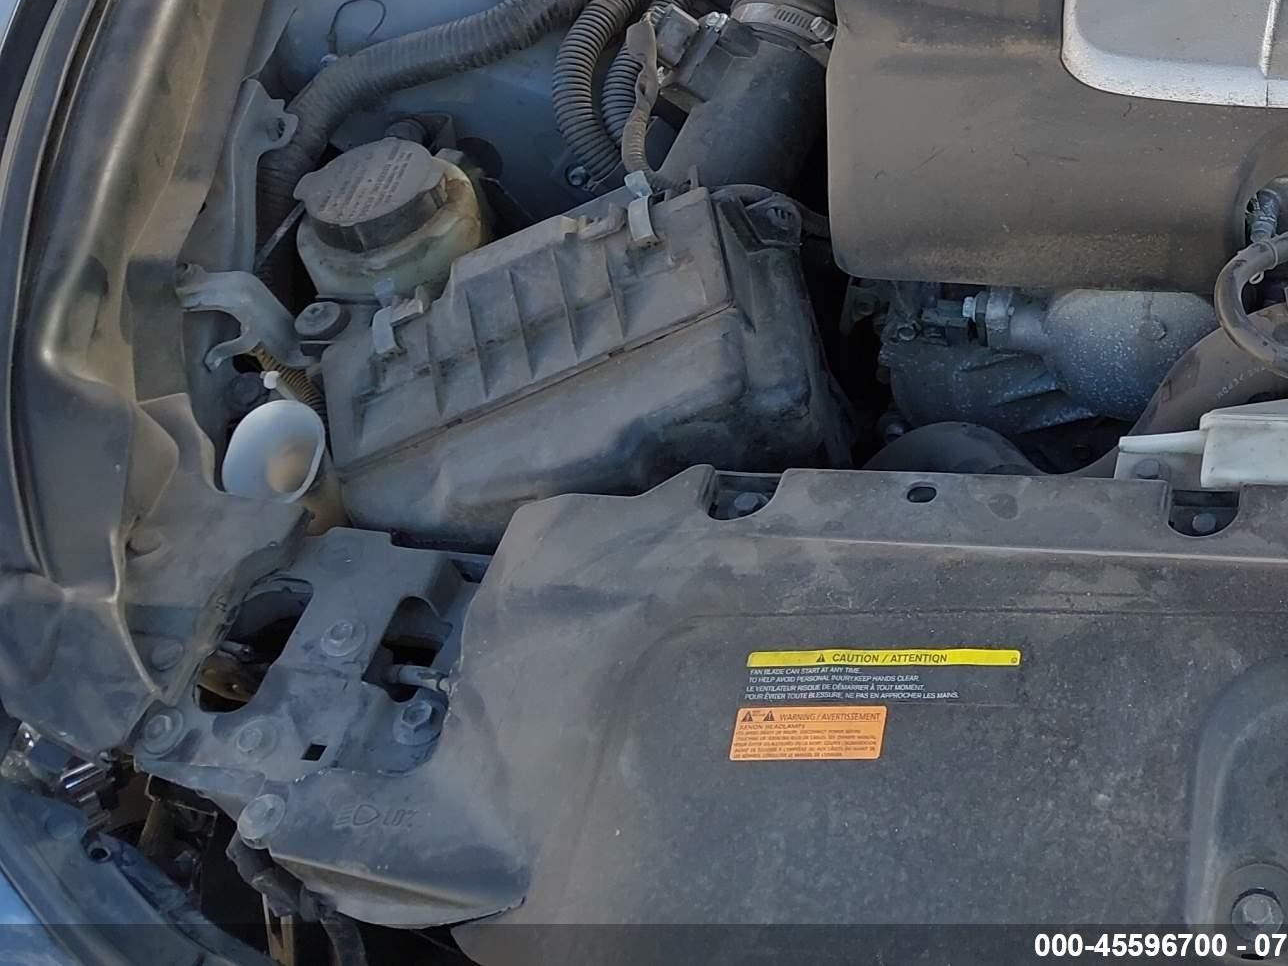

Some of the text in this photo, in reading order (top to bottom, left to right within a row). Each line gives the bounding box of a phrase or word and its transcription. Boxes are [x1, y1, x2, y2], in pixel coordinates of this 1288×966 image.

[832, 652, 880, 663] CAUTION
[889, 652, 948, 663] ATTENTION
[800, 667, 820, 675] START
[749, 676, 758, 684] TO
[876, 683, 894, 691] TOUT
[786, 692, 808, 700] TOUTE
[922, 691, 936, 699] LES
[779, 713, 817, 721] WARNING
[820, 712, 881, 721] AVERTISSEMENT
